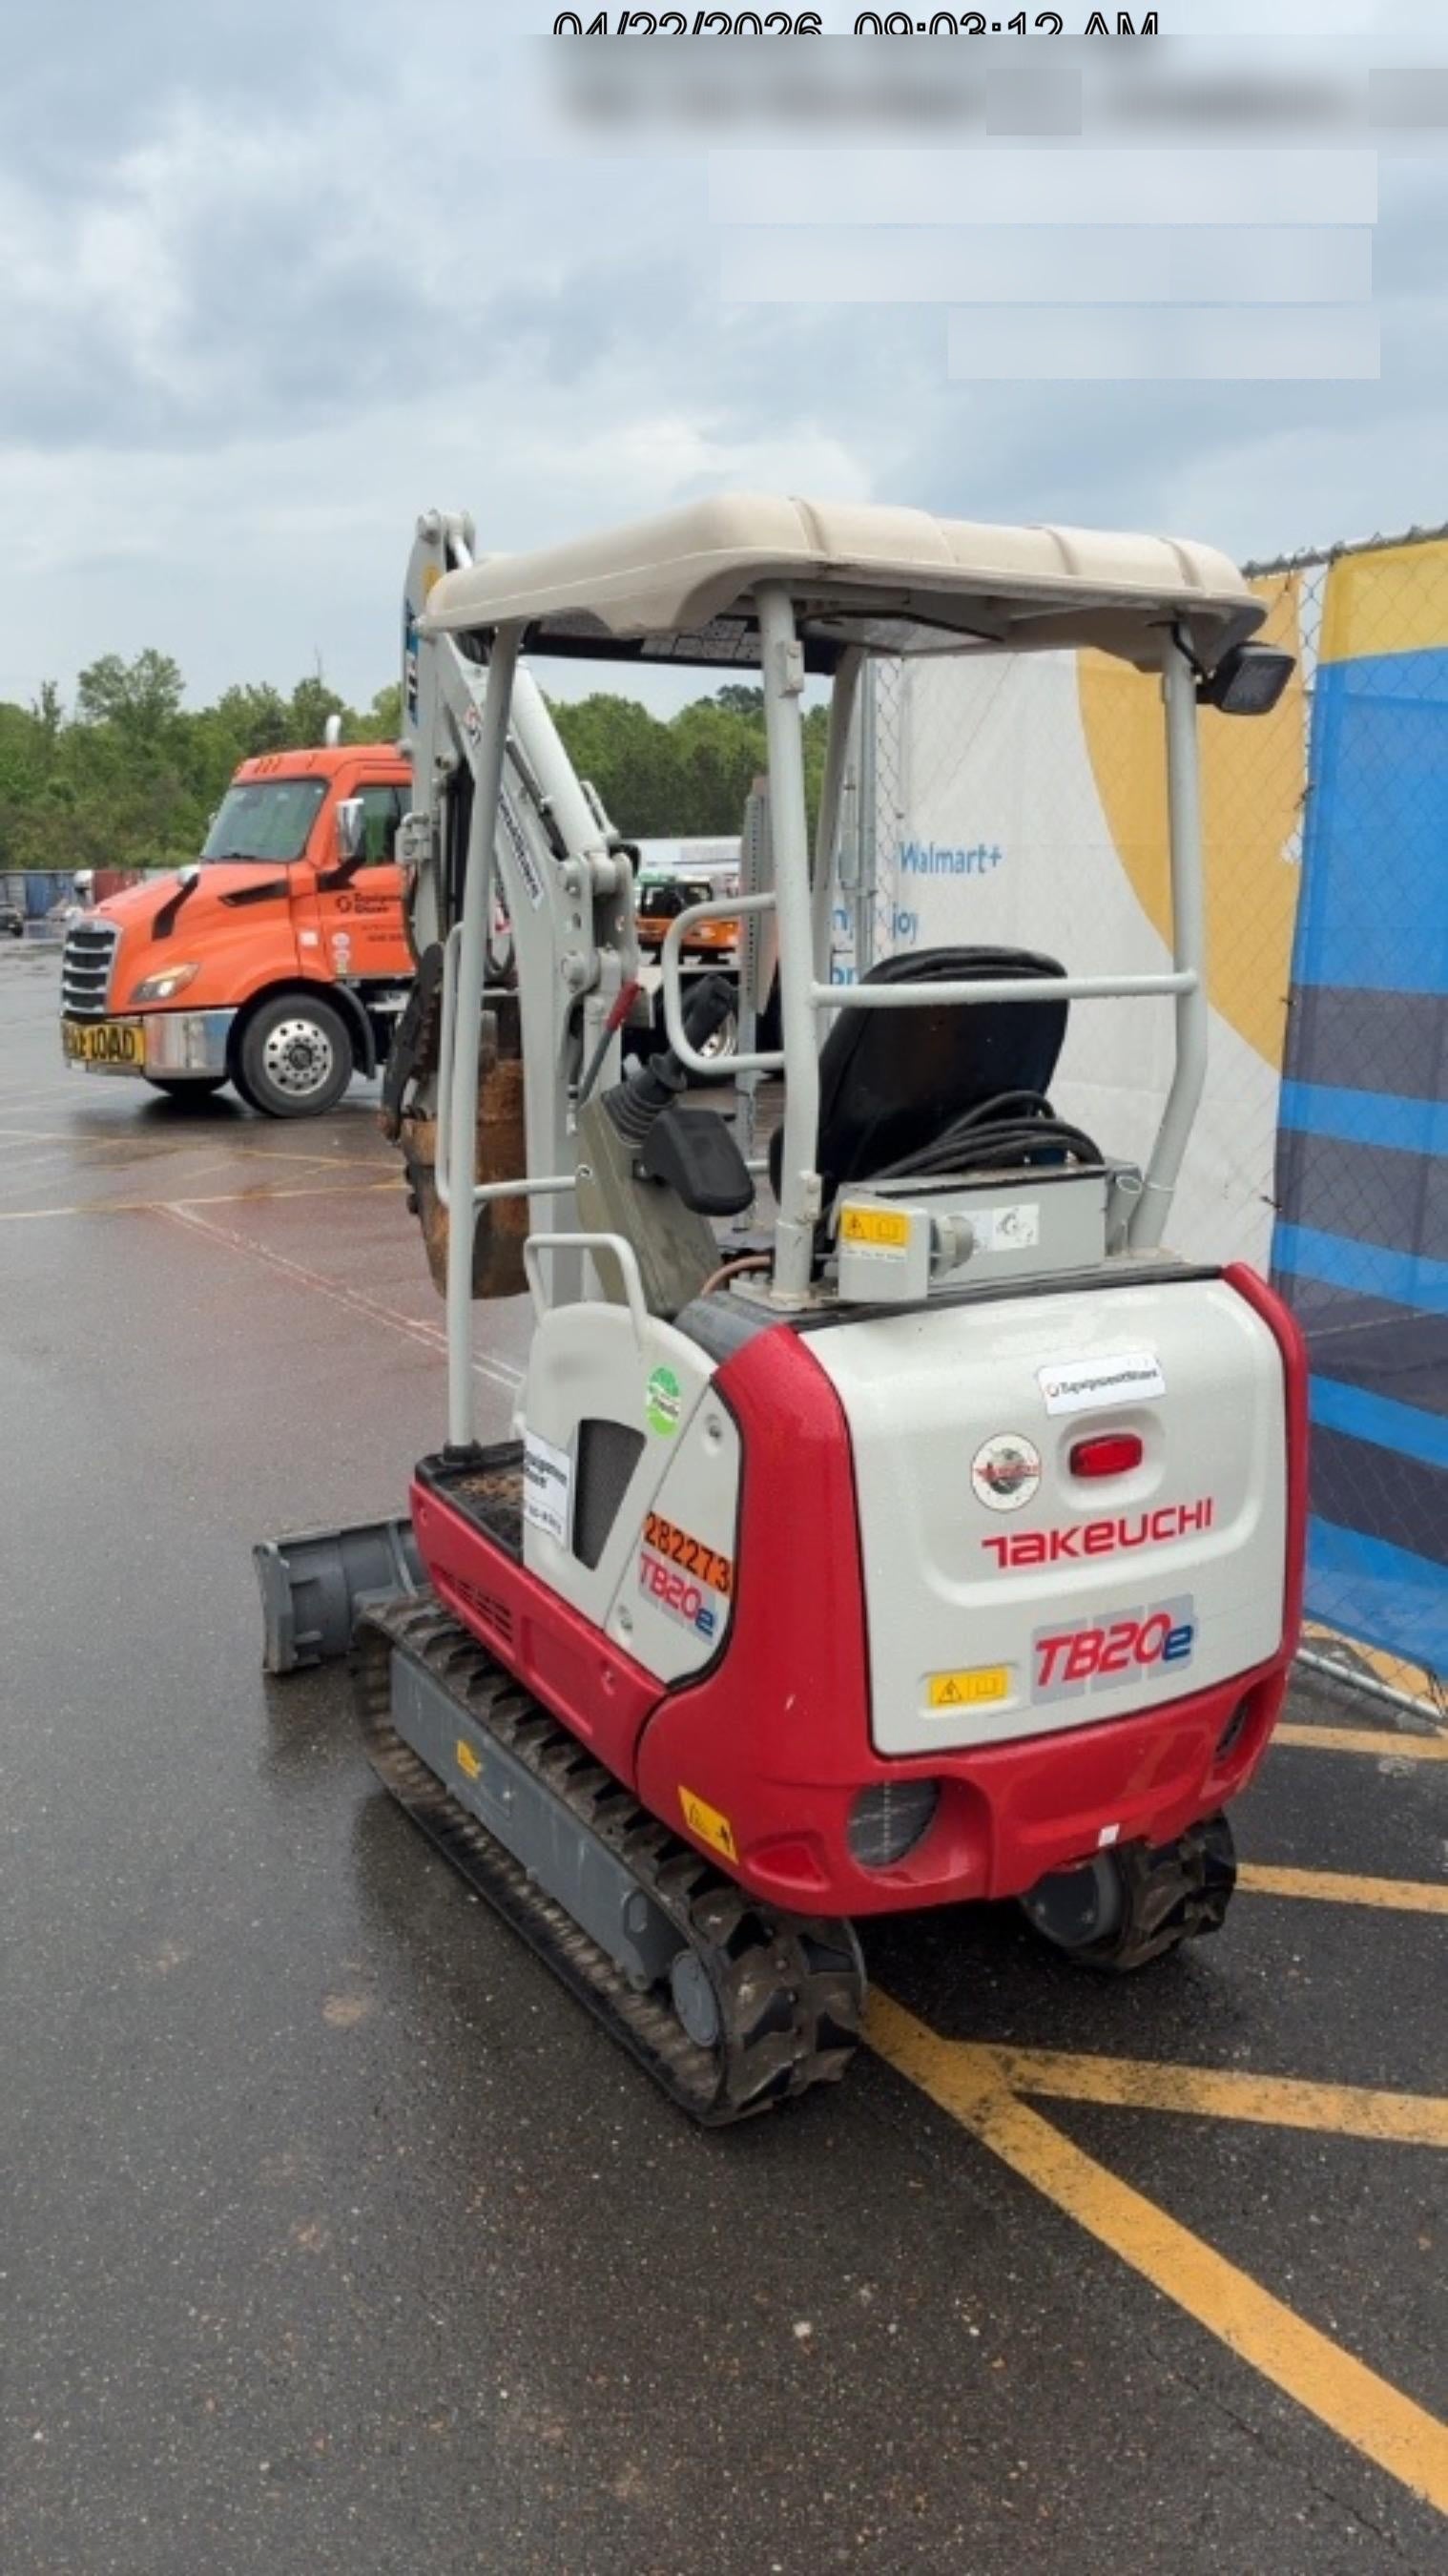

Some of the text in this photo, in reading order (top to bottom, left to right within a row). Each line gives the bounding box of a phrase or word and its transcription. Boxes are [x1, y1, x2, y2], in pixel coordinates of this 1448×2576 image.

[900, 841, 1003, 874] Walmart+
[644, 1511, 731, 1593] 282273
[640, 1550, 714, 1637] TB20e
[1035, 1612, 1192, 1687] TB20e
